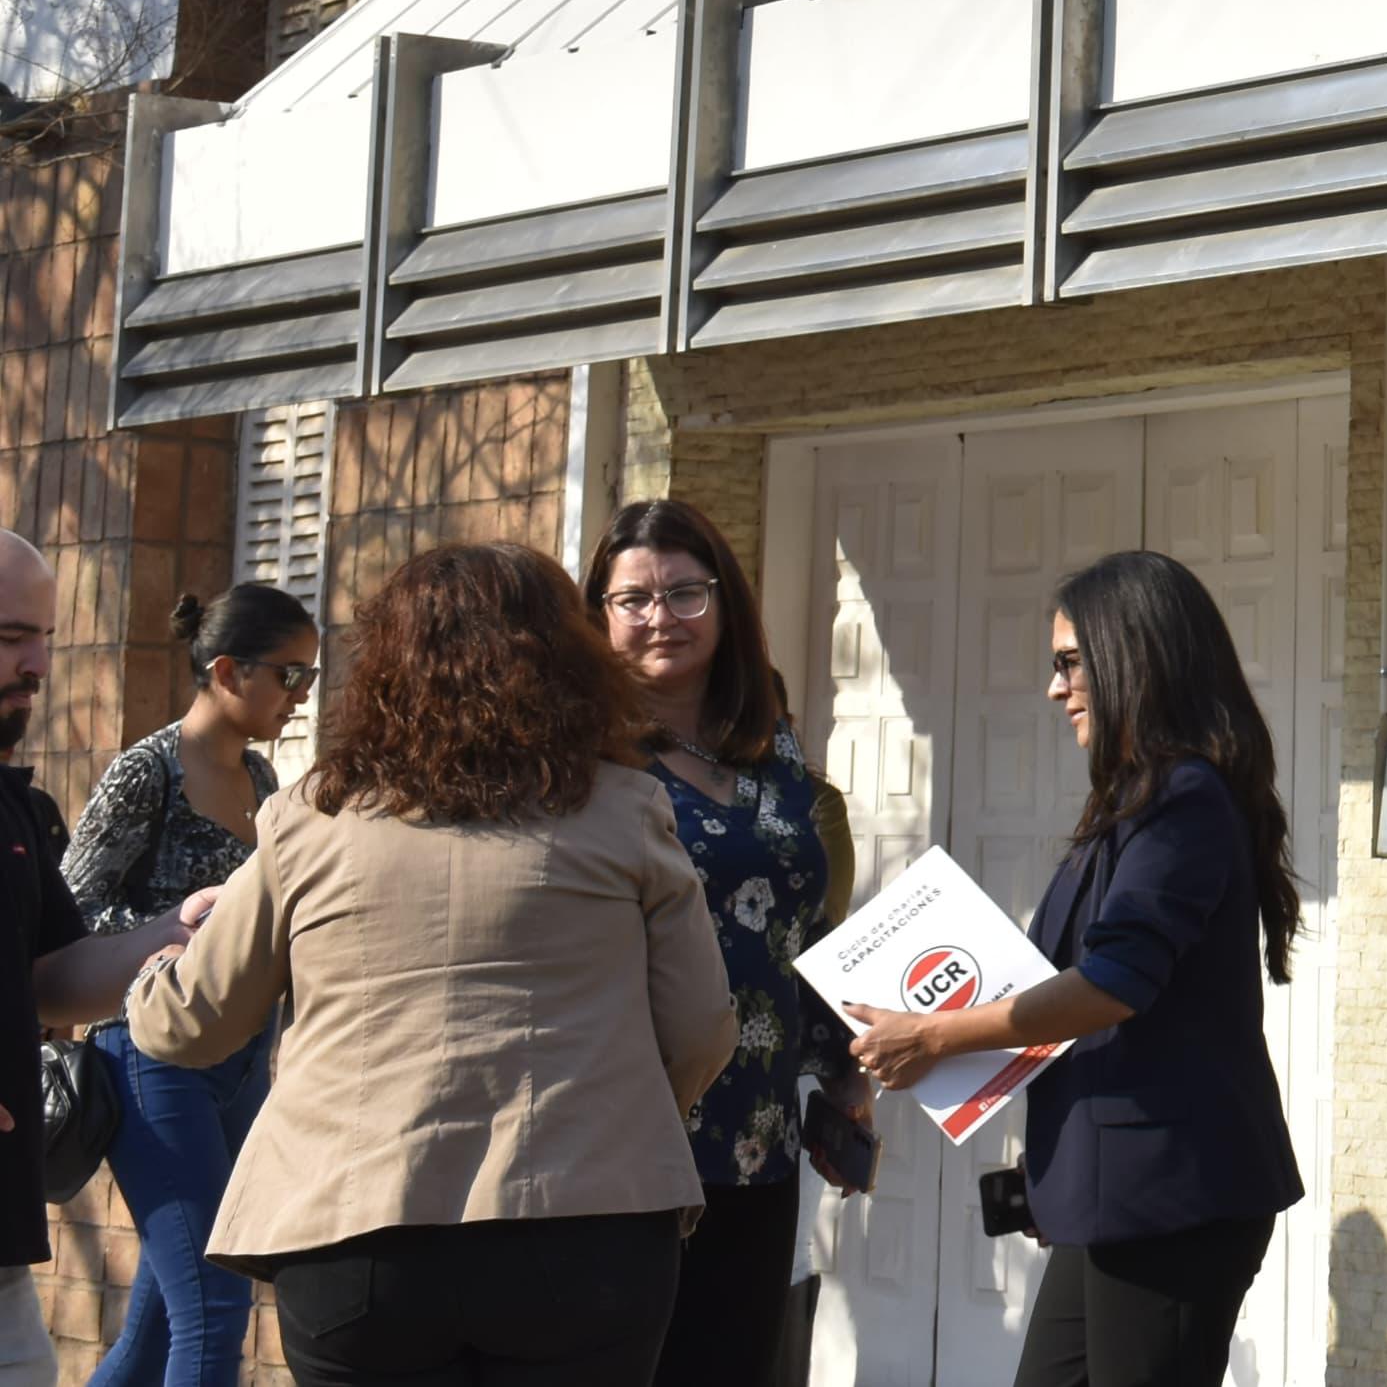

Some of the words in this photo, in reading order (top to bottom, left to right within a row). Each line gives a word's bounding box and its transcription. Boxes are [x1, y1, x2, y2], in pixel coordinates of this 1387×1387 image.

[837, 936, 869, 960] Ciclo
[871, 922, 885, 935] de
[887, 884, 928, 921] charlas
[842, 888, 942, 973] CAPACITACIONES
[913, 960, 969, 1007] UCR
